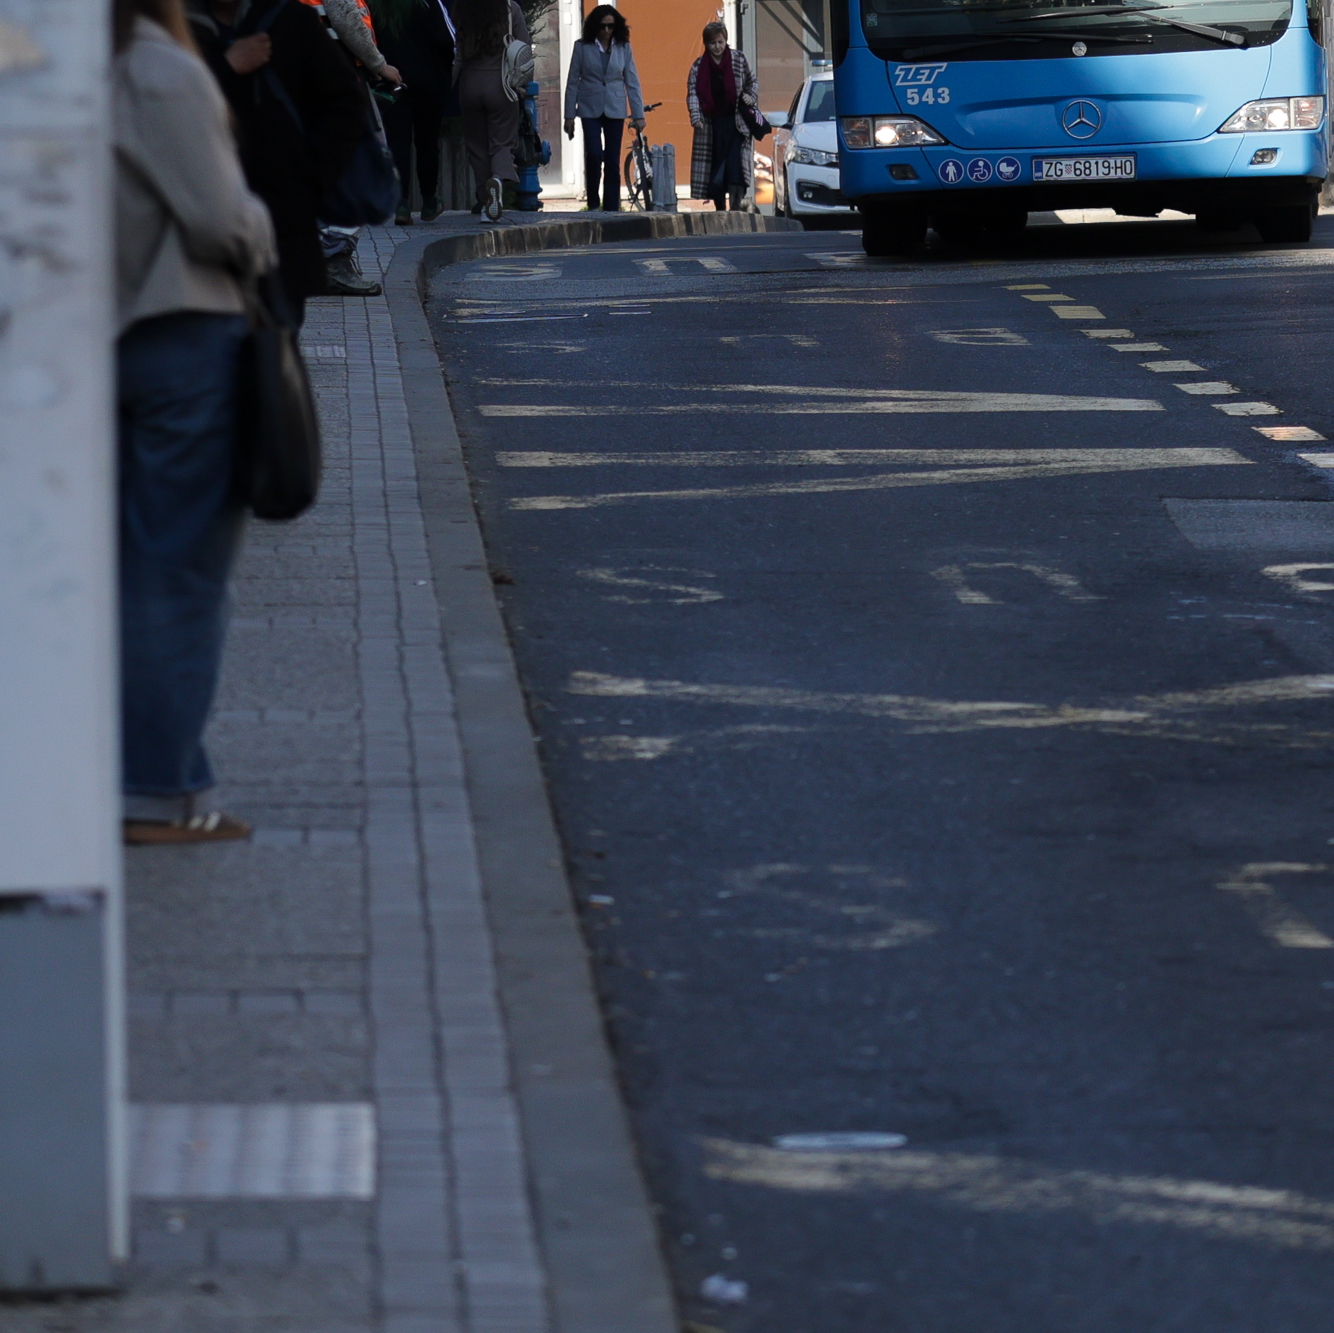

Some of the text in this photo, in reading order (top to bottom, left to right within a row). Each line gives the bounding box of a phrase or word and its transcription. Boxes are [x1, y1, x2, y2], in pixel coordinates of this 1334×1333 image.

[894, 62, 948, 86] ZET
[906, 87, 951, 106] 543
[1044, 161, 1064, 178] ZG
